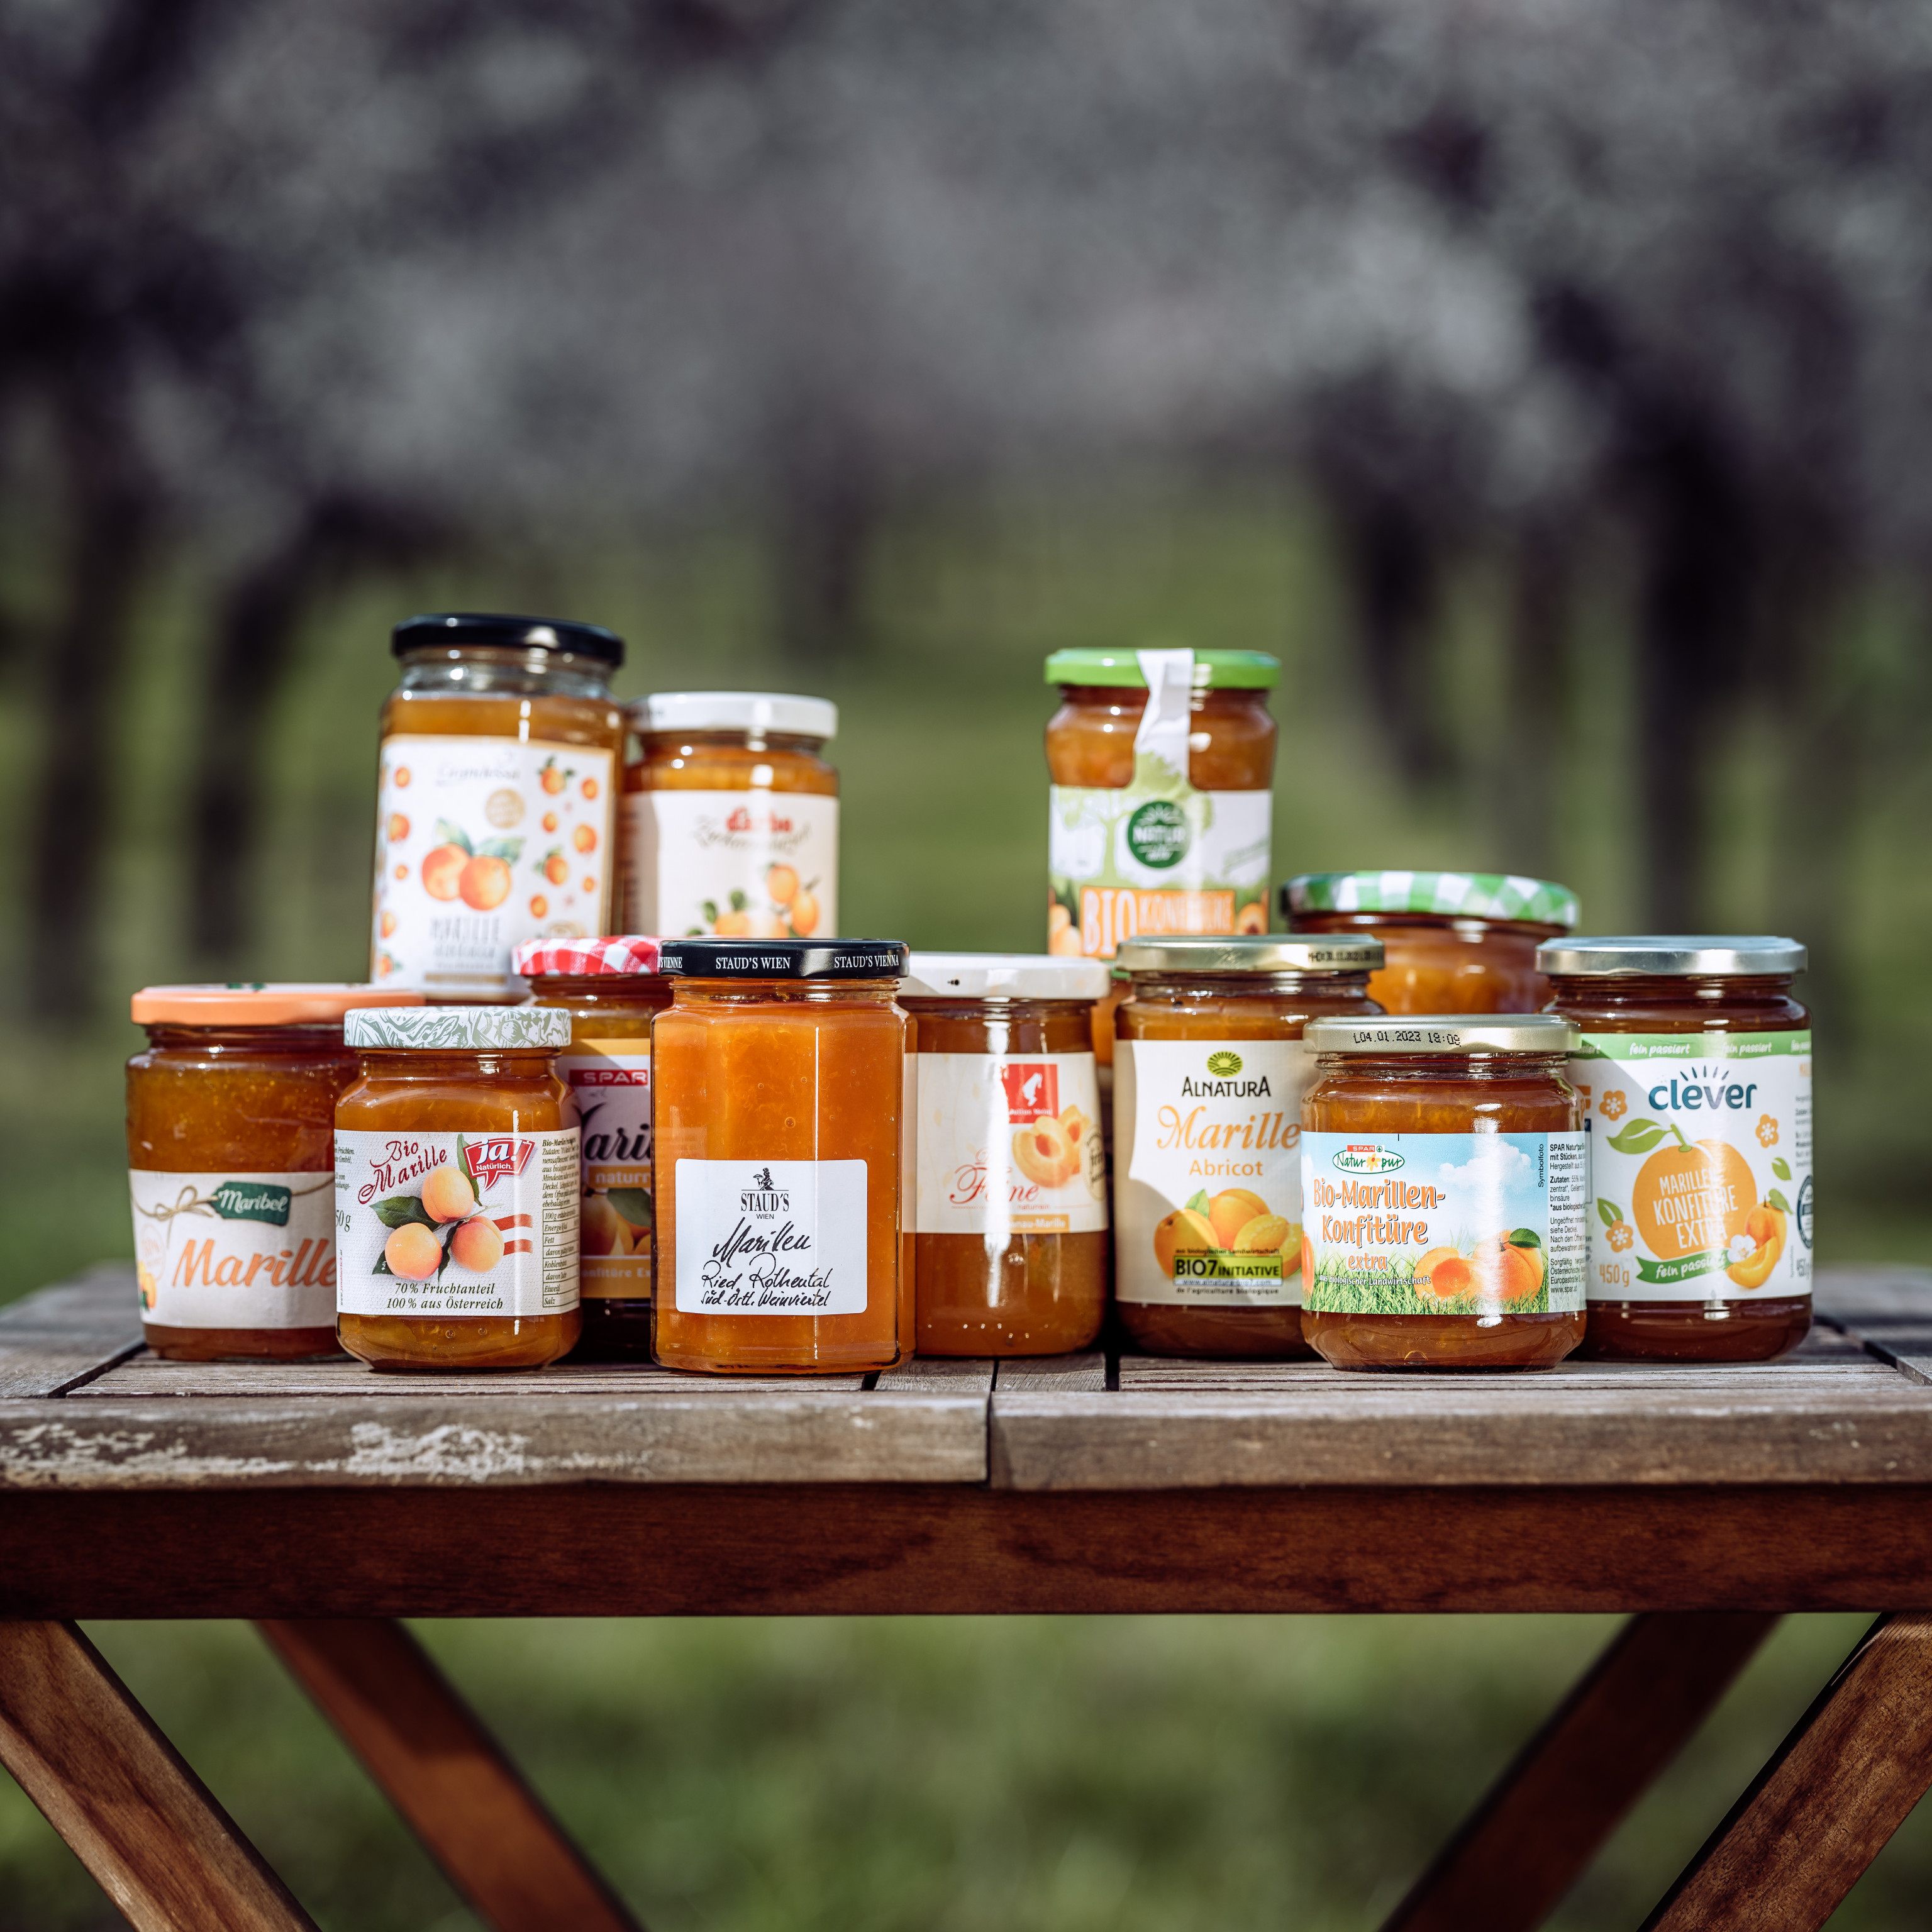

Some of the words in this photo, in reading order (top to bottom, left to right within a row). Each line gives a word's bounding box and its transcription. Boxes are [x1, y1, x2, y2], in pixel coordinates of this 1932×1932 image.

[1082, 890, 1137, 954] BIO
[663, 957, 682, 969] VIENNE
[716, 957, 758, 969] STAUD'S
[762, 957, 791, 969] WIEN
[834, 956, 873, 969] STAUD'S
[875, 954, 899, 967] VIENNA
[1353, 1031, 1421, 1043] L04.01.2023
[1648, 1043, 1690, 1057] passiert
[1738, 1042, 1772, 1056] passiert
[583, 1072, 648, 1084] SPAR
[1181, 1075, 1272, 1097] ALNATURA
[1648, 1079, 1757, 1111] clever
[1156, 1104, 1301, 1150] Marille
[370, 1141, 418, 1168] Bio
[476, 1138, 523, 1164] ja!
[1550, 1143, 1565, 1152] SPAR
[476, 1163, 513, 1171] Natürlich.
[1189, 1159, 1263, 1176] Abricot
[1337, 1153, 1367, 1167] Natur
[1381, 1157, 1402, 1170] pur
[1550, 1161, 1574, 1171] Hergestellt
[358, 1145, 447, 1205] Marille
[1313, 1177, 1446, 1209] Bio-Marillen-
[219, 1189, 289, 1214] Maribel
[740, 1192, 790, 1211] STAUD'S
[1550, 1217, 1574, 1226] Ungeöffnet
[1321, 1213, 1429, 1248] Konfitüre
[544, 1236, 555, 1244] Fett
[172, 1237, 336, 1287] Marille
[1347, 1252, 1388, 1271] extra
[1319, 1274, 1328, 1282] aus
[1329, 1275, 1367, 1285] biologischer
[1368, 1275, 1431, 1286] Landwirtschaft
[1599, 1263, 1619, 1284] 450
[1623, 1270, 1629, 1288] g
[422, 1282, 496, 1294] Fruchtanteil
[421, 1300, 441, 1309] aus
[446, 1296, 503, 1309] Österreich
[544, 1297, 555, 1305] Salz
